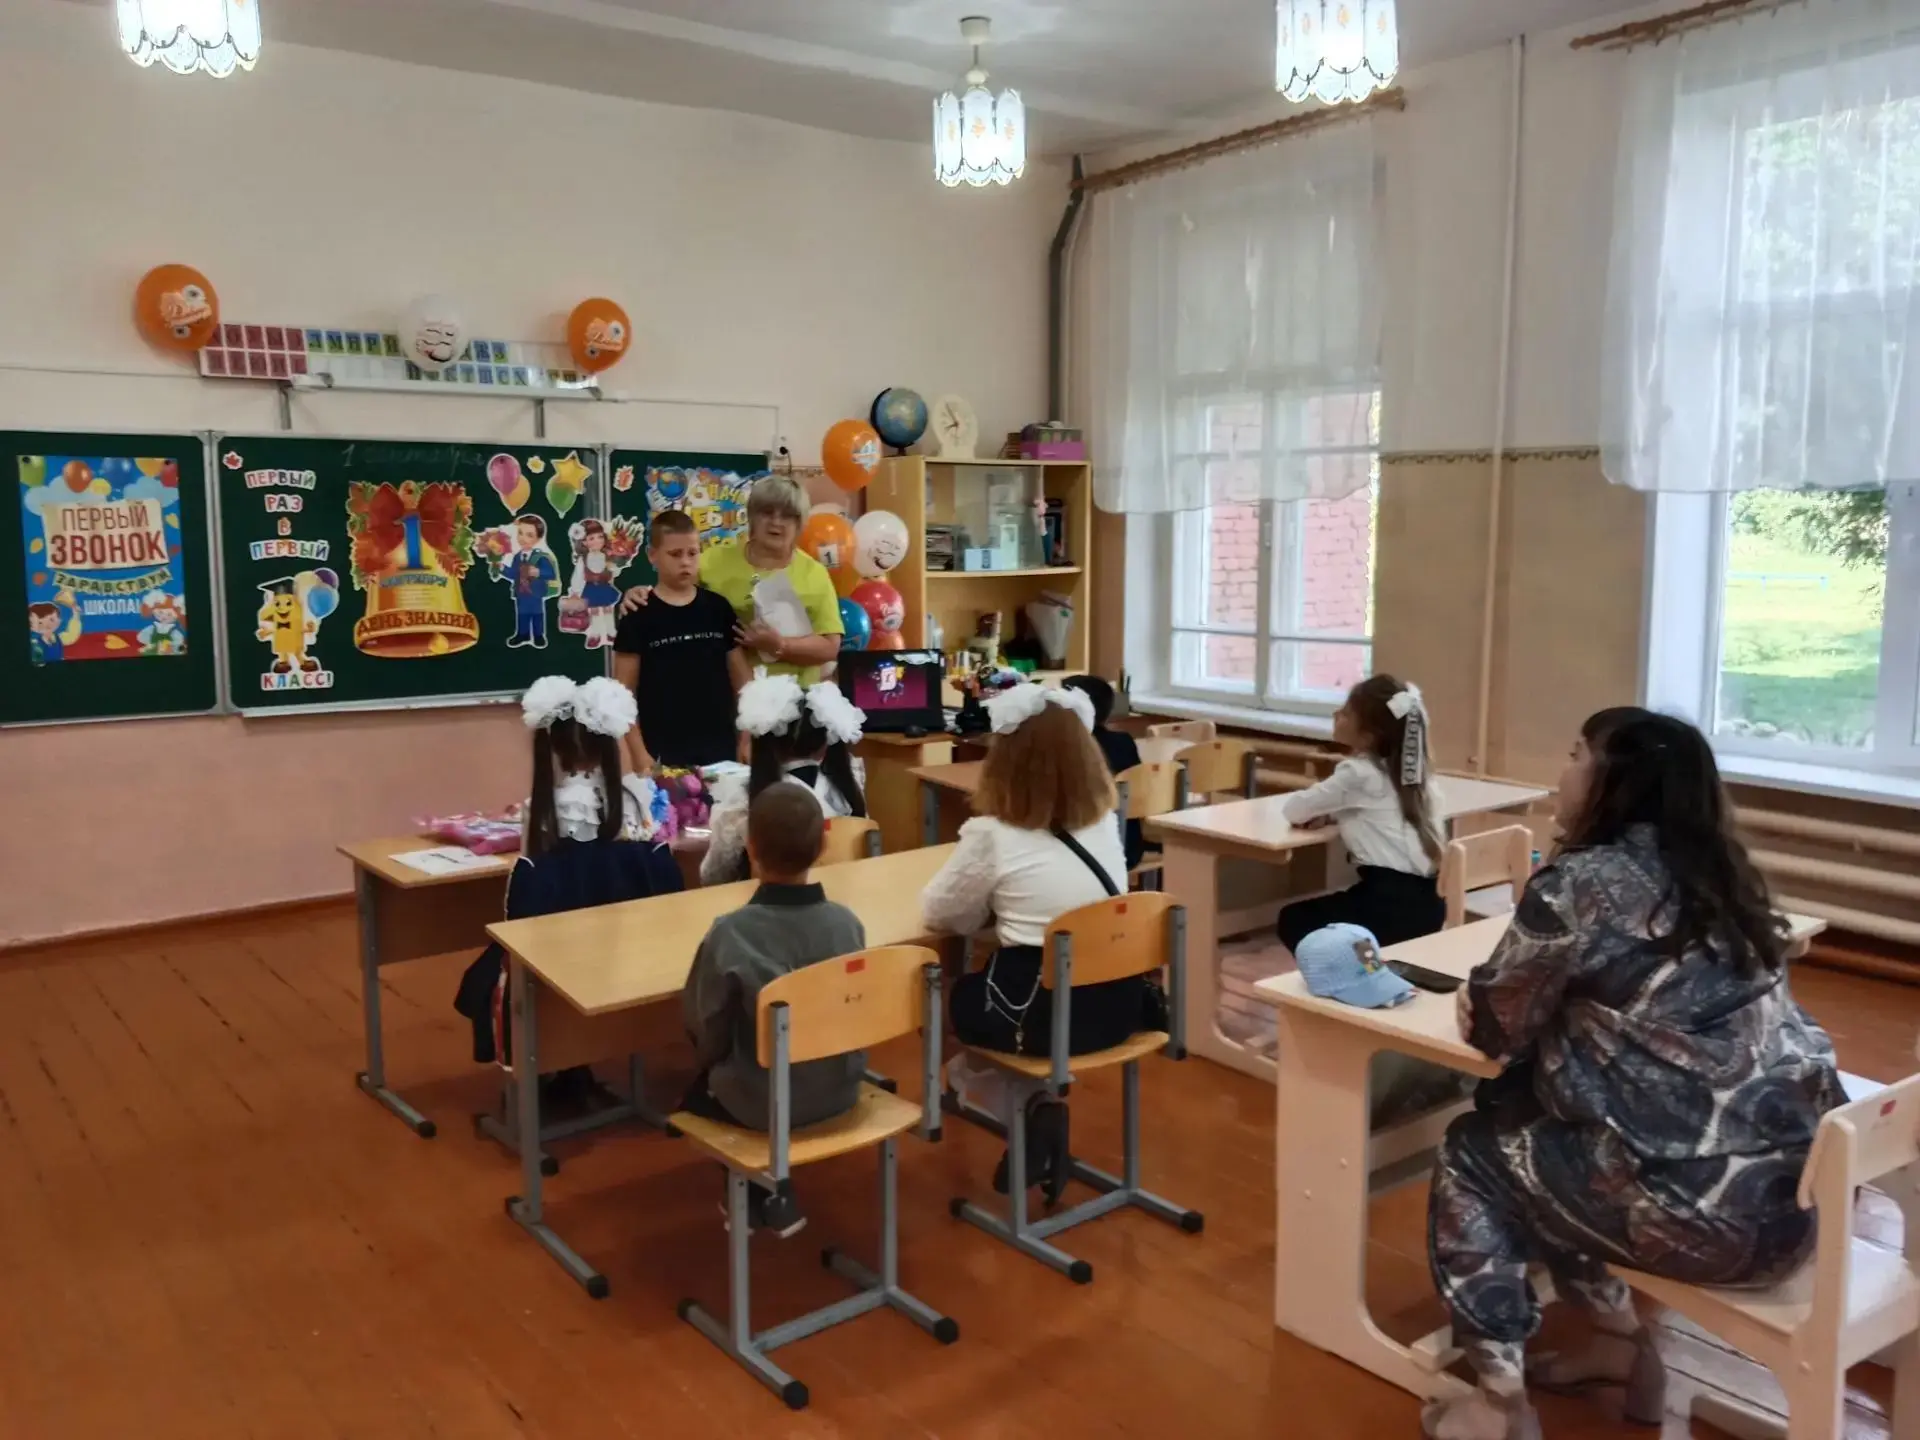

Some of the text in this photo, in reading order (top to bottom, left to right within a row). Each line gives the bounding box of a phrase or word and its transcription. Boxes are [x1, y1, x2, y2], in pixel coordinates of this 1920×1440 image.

[246, 471, 315, 487] ПЕРВЫЙ
[267, 496, 302, 511] РАЗ
[62, 500, 149, 531] ПЕРВЫЙ
[50, 531, 166, 565] ЗВОНОК
[252, 542, 328, 559] ПЕРВЫЙ
[83, 598, 140, 616] ШКОЛА!
[358, 610, 474, 635] ДЕНЬ ЗНАНИЙ
[263, 672, 332, 689] КЛАСС!
